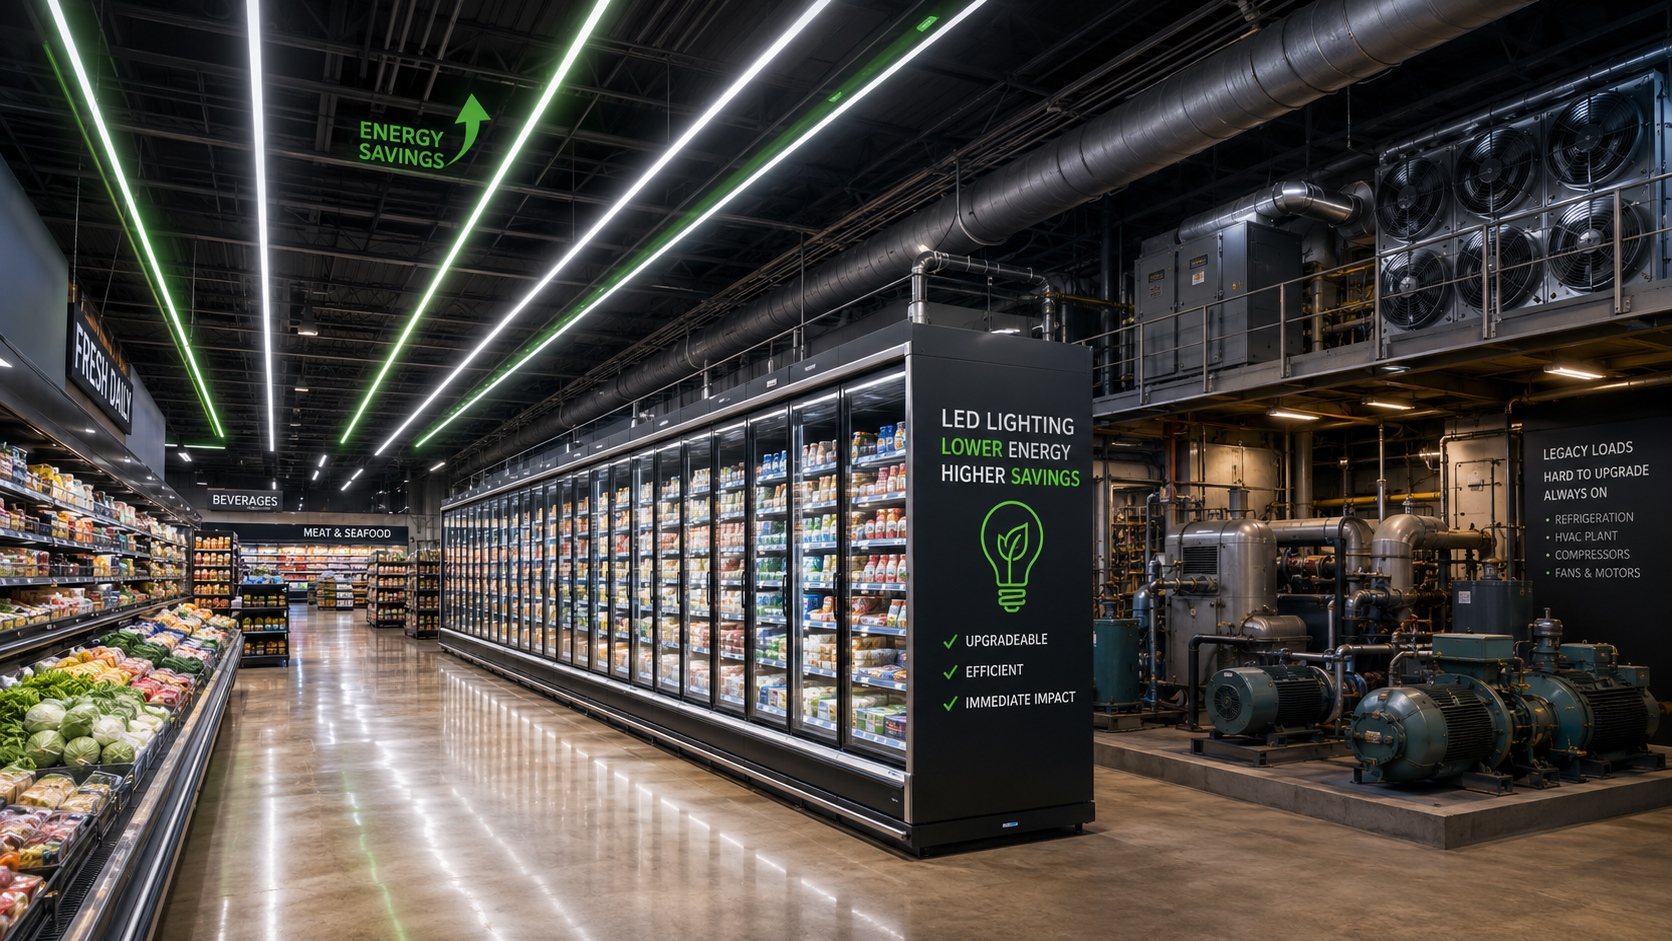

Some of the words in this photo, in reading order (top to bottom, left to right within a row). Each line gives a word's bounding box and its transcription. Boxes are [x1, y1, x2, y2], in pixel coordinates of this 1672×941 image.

[361, 121, 443, 147] ENERGY
[359, 143, 444, 169] SAVINGS
[75, 321, 108, 400] FRESH
[110, 368, 132, 424] DAILY
[942, 408, 980, 429] LED
[987, 412, 1074, 435] LIGHTING
[942, 437, 1003, 457] LOWER
[1009, 442, 1071, 461] ENERGY
[1544, 445, 1588, 460] LEGACY
[1592, 441, 1633, 456] LOADS
[942, 464, 1005, 484] HIGHER
[1011, 467, 1080, 487] SAVINGS
[1544, 470, 1574, 482] HARD
[1577, 469, 1591, 480] TO
[1595, 464, 1649, 479] UPGRADE
[212, 494, 277, 508] BEVERAGES
[1544, 488, 1587, 501] ALWAYS
[1591, 487, 1607, 498] ON
[1555, 512, 1634, 525] REFRIGERATION
[304, 528, 331, 537] MEAT
[334, 528, 342, 537] &
[344, 528, 391, 538] SEAFOOD
[1555, 532, 1582, 542] HVAC
[1585, 531, 1618, 541] PLANT
[1555, 549, 1630, 560] COMPRESSORS
[1555, 568, 1581, 578] FANS
[1585, 568, 1592, 578] &
[1596, 568, 1640, 578] MOTORS
[966, 633, 1048, 647] UPGRADEABLE
[966, 663, 1024, 678] EFFICIENT
[966, 693, 1031, 709] IMMEDIATE
[1034, 690, 1076, 704] IMPACT
